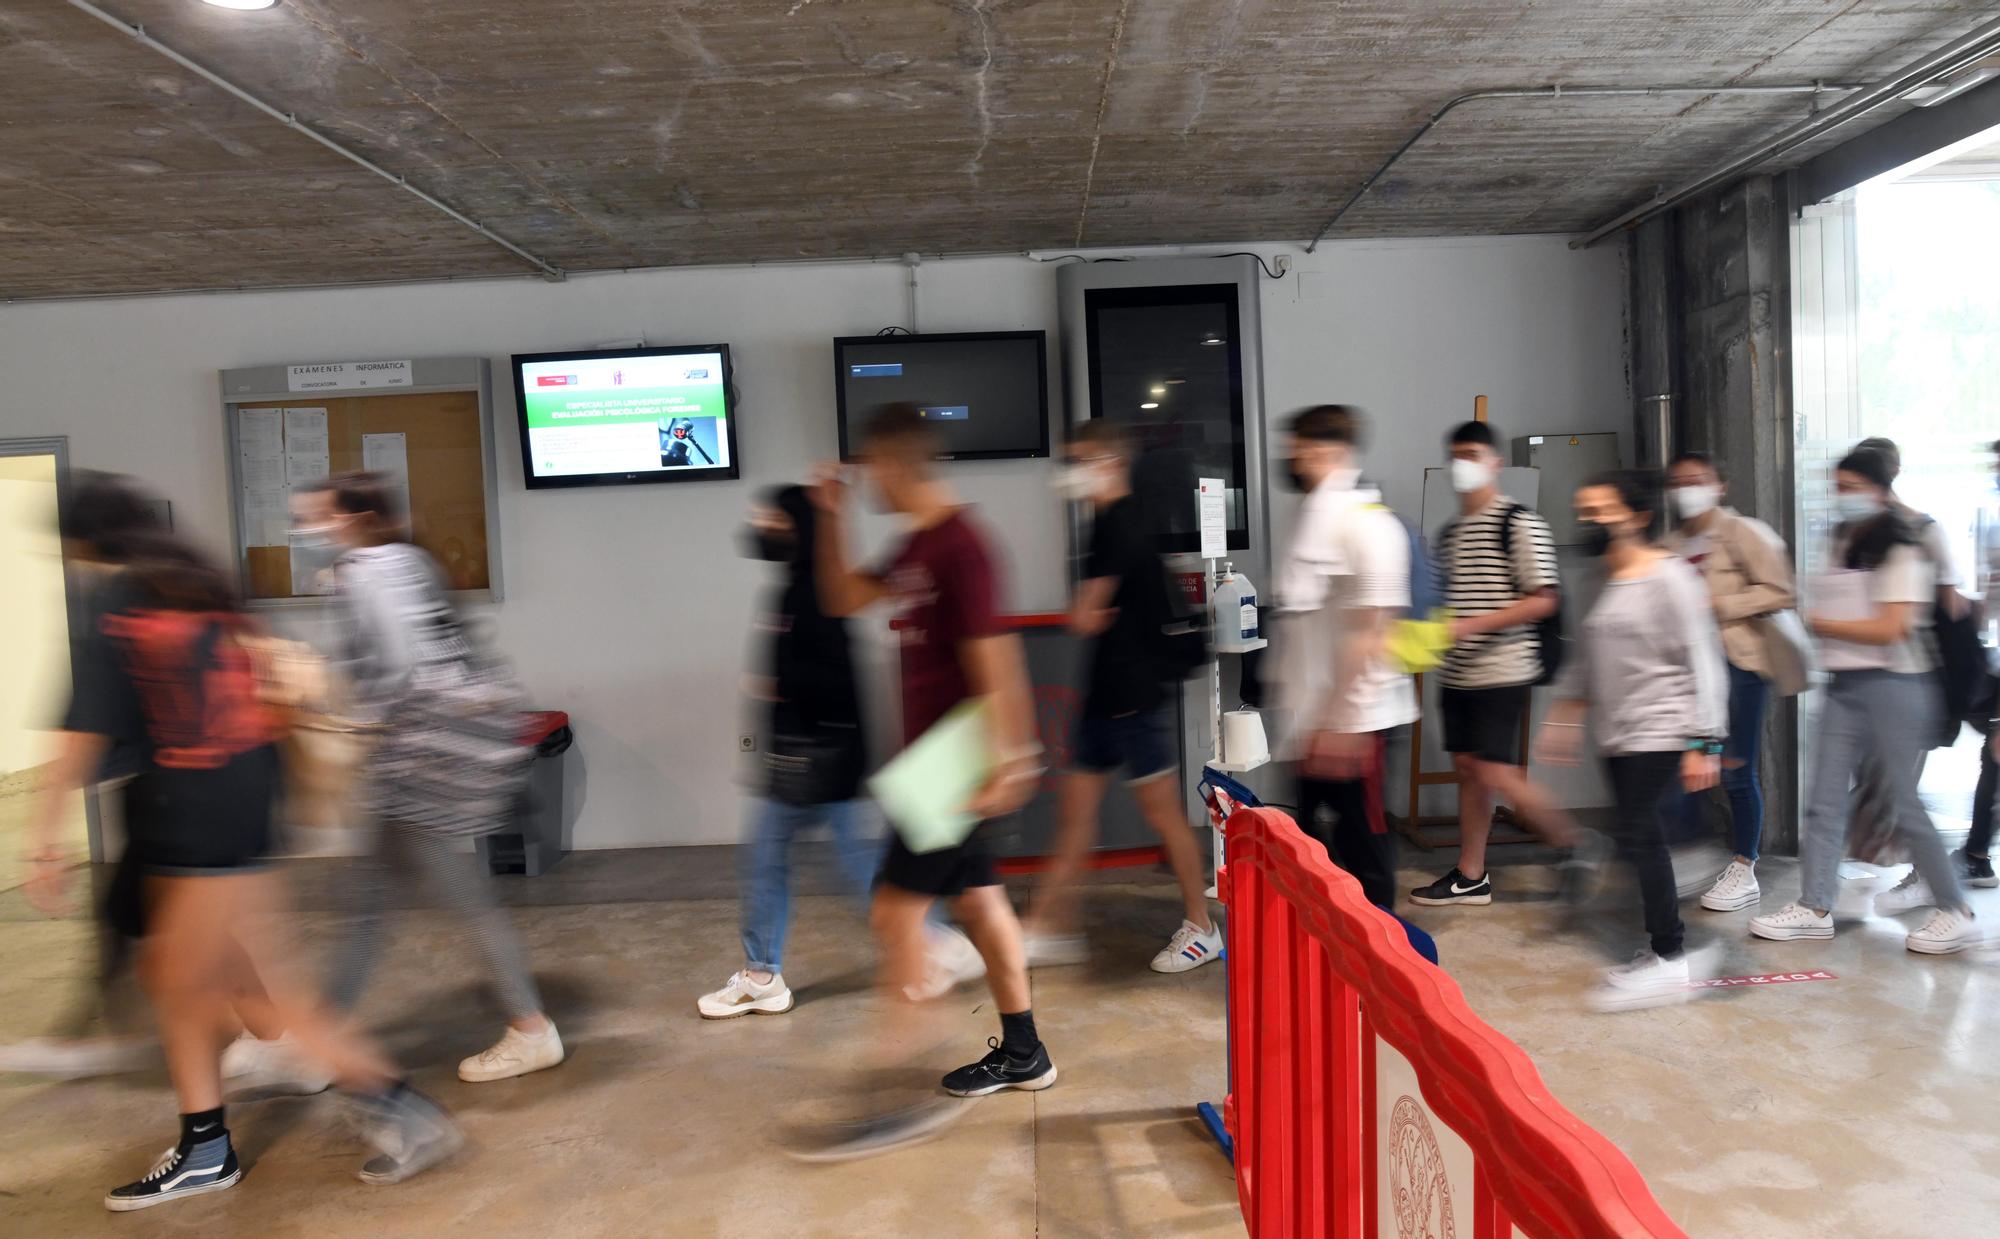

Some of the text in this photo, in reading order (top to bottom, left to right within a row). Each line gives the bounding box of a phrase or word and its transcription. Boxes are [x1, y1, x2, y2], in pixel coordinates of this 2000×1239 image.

[294, 361, 405, 375] EXÁMENES INFORMÁTICA
[1688, 971, 1832, 987] ENTRADA
